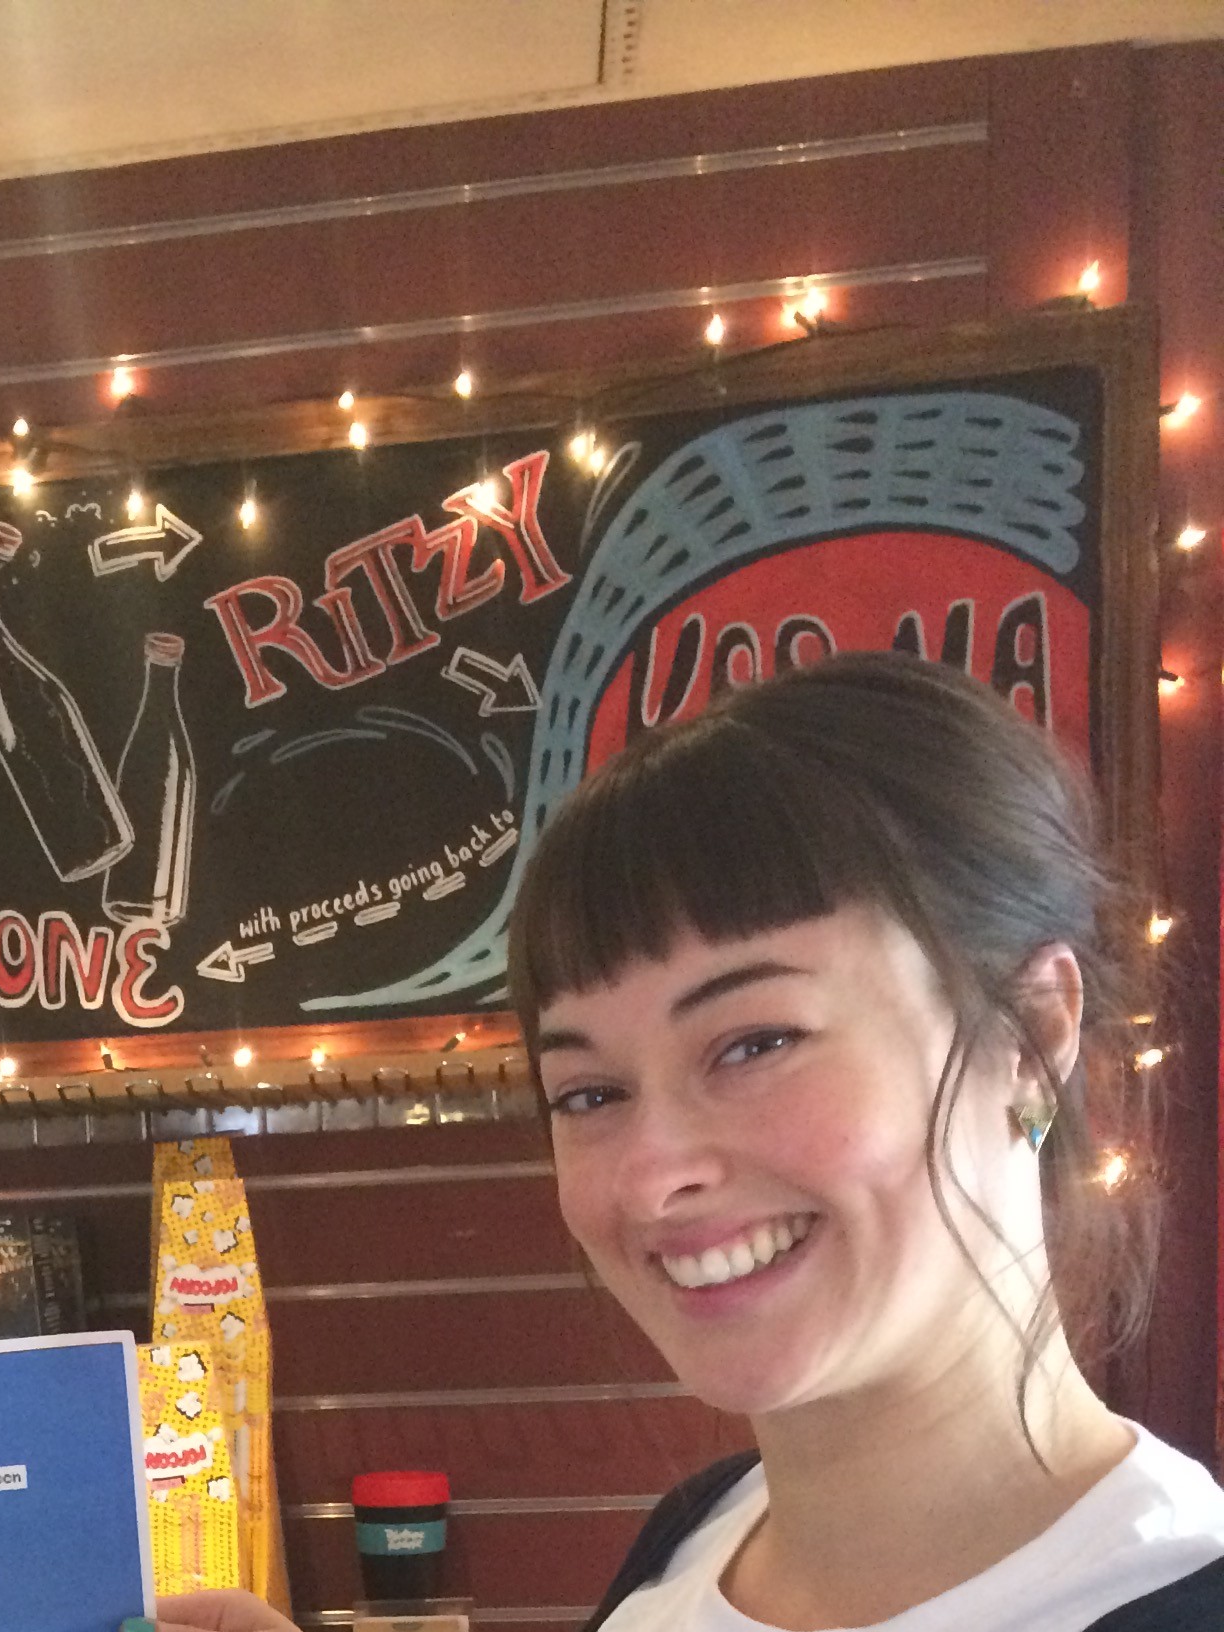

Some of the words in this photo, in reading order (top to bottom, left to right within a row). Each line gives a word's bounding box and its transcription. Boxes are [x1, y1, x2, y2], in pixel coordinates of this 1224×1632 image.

[203, 449, 574, 709] RITZY
[239, 905, 281, 939] with
[289, 880, 383, 932] proceeds
[389, 860, 444, 899] going
[444, 824, 492, 869] back
[490, 808, 514, 832] to
